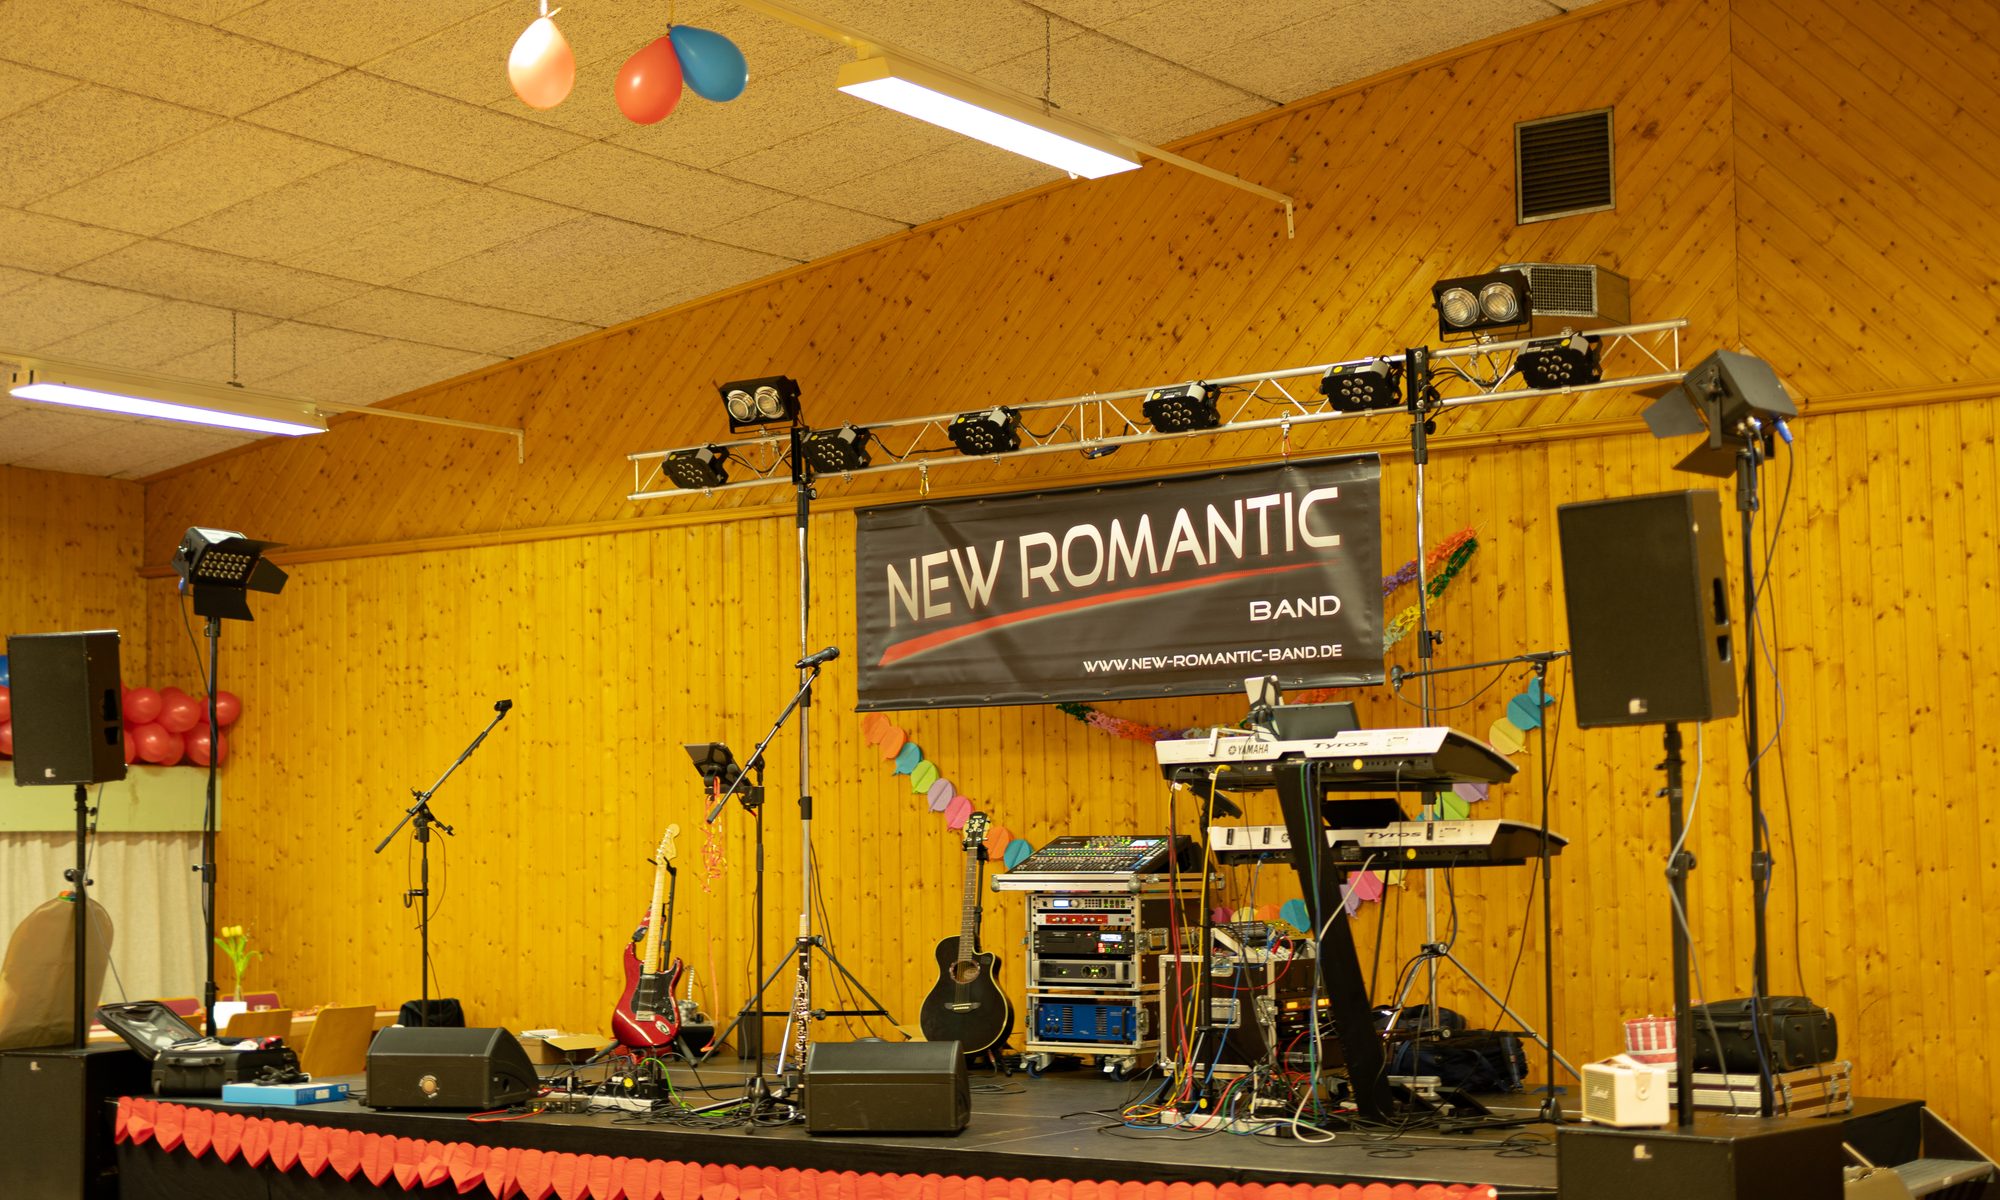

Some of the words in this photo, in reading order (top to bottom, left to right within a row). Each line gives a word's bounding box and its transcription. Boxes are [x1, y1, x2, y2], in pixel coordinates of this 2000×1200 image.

[886, 540, 1004, 627] NEW
[1020, 487, 1340, 598] ROMANTIC
[1249, 595, 1341, 621] BAND
[1083, 643, 1343, 673] WWW.NEW-ROMANTIC-BAND.DE
[1238, 743, 1269, 755] YAMAHA
[1313, 740, 1369, 750] Tyros
[1364, 830, 1422, 840] Tyros
